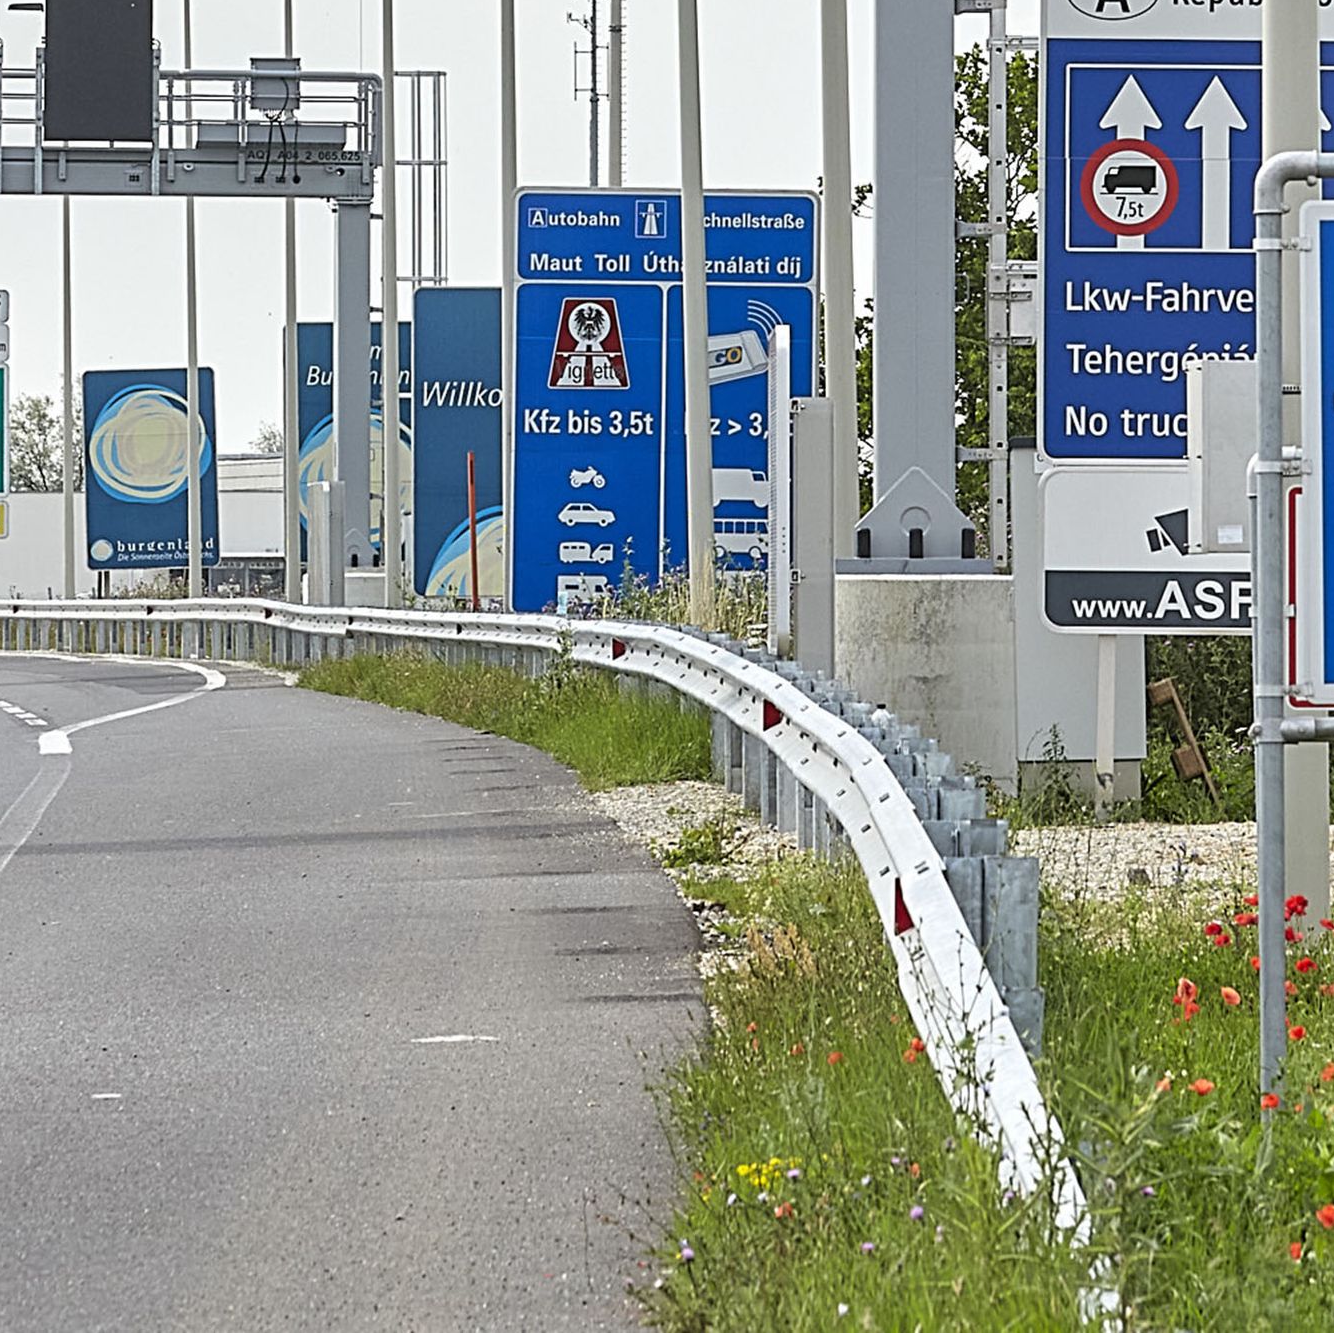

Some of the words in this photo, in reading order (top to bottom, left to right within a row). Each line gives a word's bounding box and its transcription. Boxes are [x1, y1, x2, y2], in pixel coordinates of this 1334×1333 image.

[531, 211, 620, 227] Autobahn
[703, 213, 805, 230] chnellstraße
[1115, 196, 1144, 221] 7,5t
[530, 253, 583, 271] Maut
[594, 254, 630, 272] Toll
[643, 251, 770, 274] Úthználati
[776, 256, 802, 279] díj
[1066, 281, 1255, 313] Lkw-Fahrve
[422, 381, 503, 407] Willko
[523, 408, 561, 434] Kfz
[568, 409, 603, 435] bis
[609, 410, 654, 438] 3,5t
[1066, 406, 1109, 437] No
[117, 537, 214, 553] burgenld
